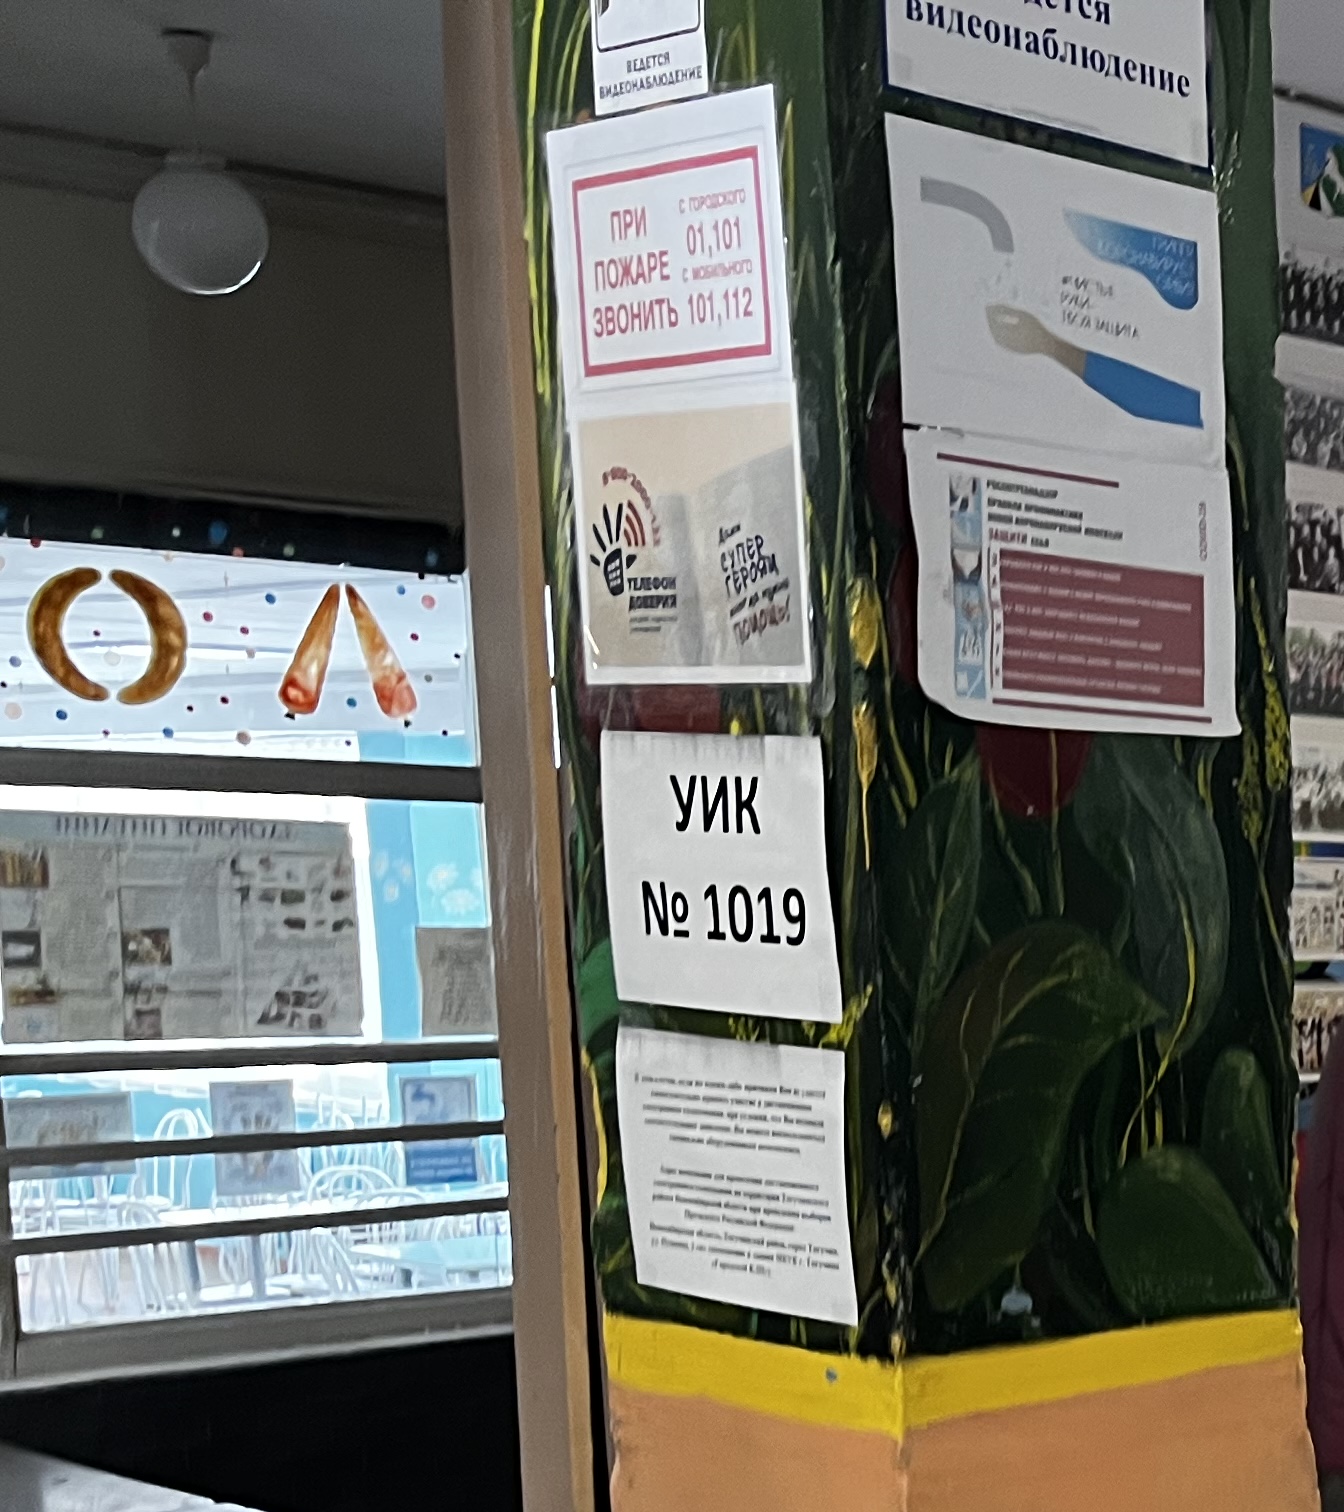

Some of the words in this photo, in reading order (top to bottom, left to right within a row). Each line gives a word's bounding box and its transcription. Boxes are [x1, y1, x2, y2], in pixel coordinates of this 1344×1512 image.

[599, 65, 703, 99] ВИДЕОНАБЛЮДЕНИЕ
[626, 51, 671, 74] ВЕДЕТСЯ
[688, 188, 747, 211] ГОРОДСКОГО
[610, 206, 648, 242] ПРИ
[686, 216, 742, 258] 01,101
[594, 250, 671, 292] ПОЖАРЕ
[692, 258, 753, 281] МОБИЛЬНОГО
[593, 298, 679, 338] ЗВОНИТЬ
[687, 286, 754, 327] 101,112
[720, 534, 765, 573] СУПЕР
[669, 774, 762, 836] УИК
[641, 880, 690, 938] №
[706, 884, 808, 947] 1019
